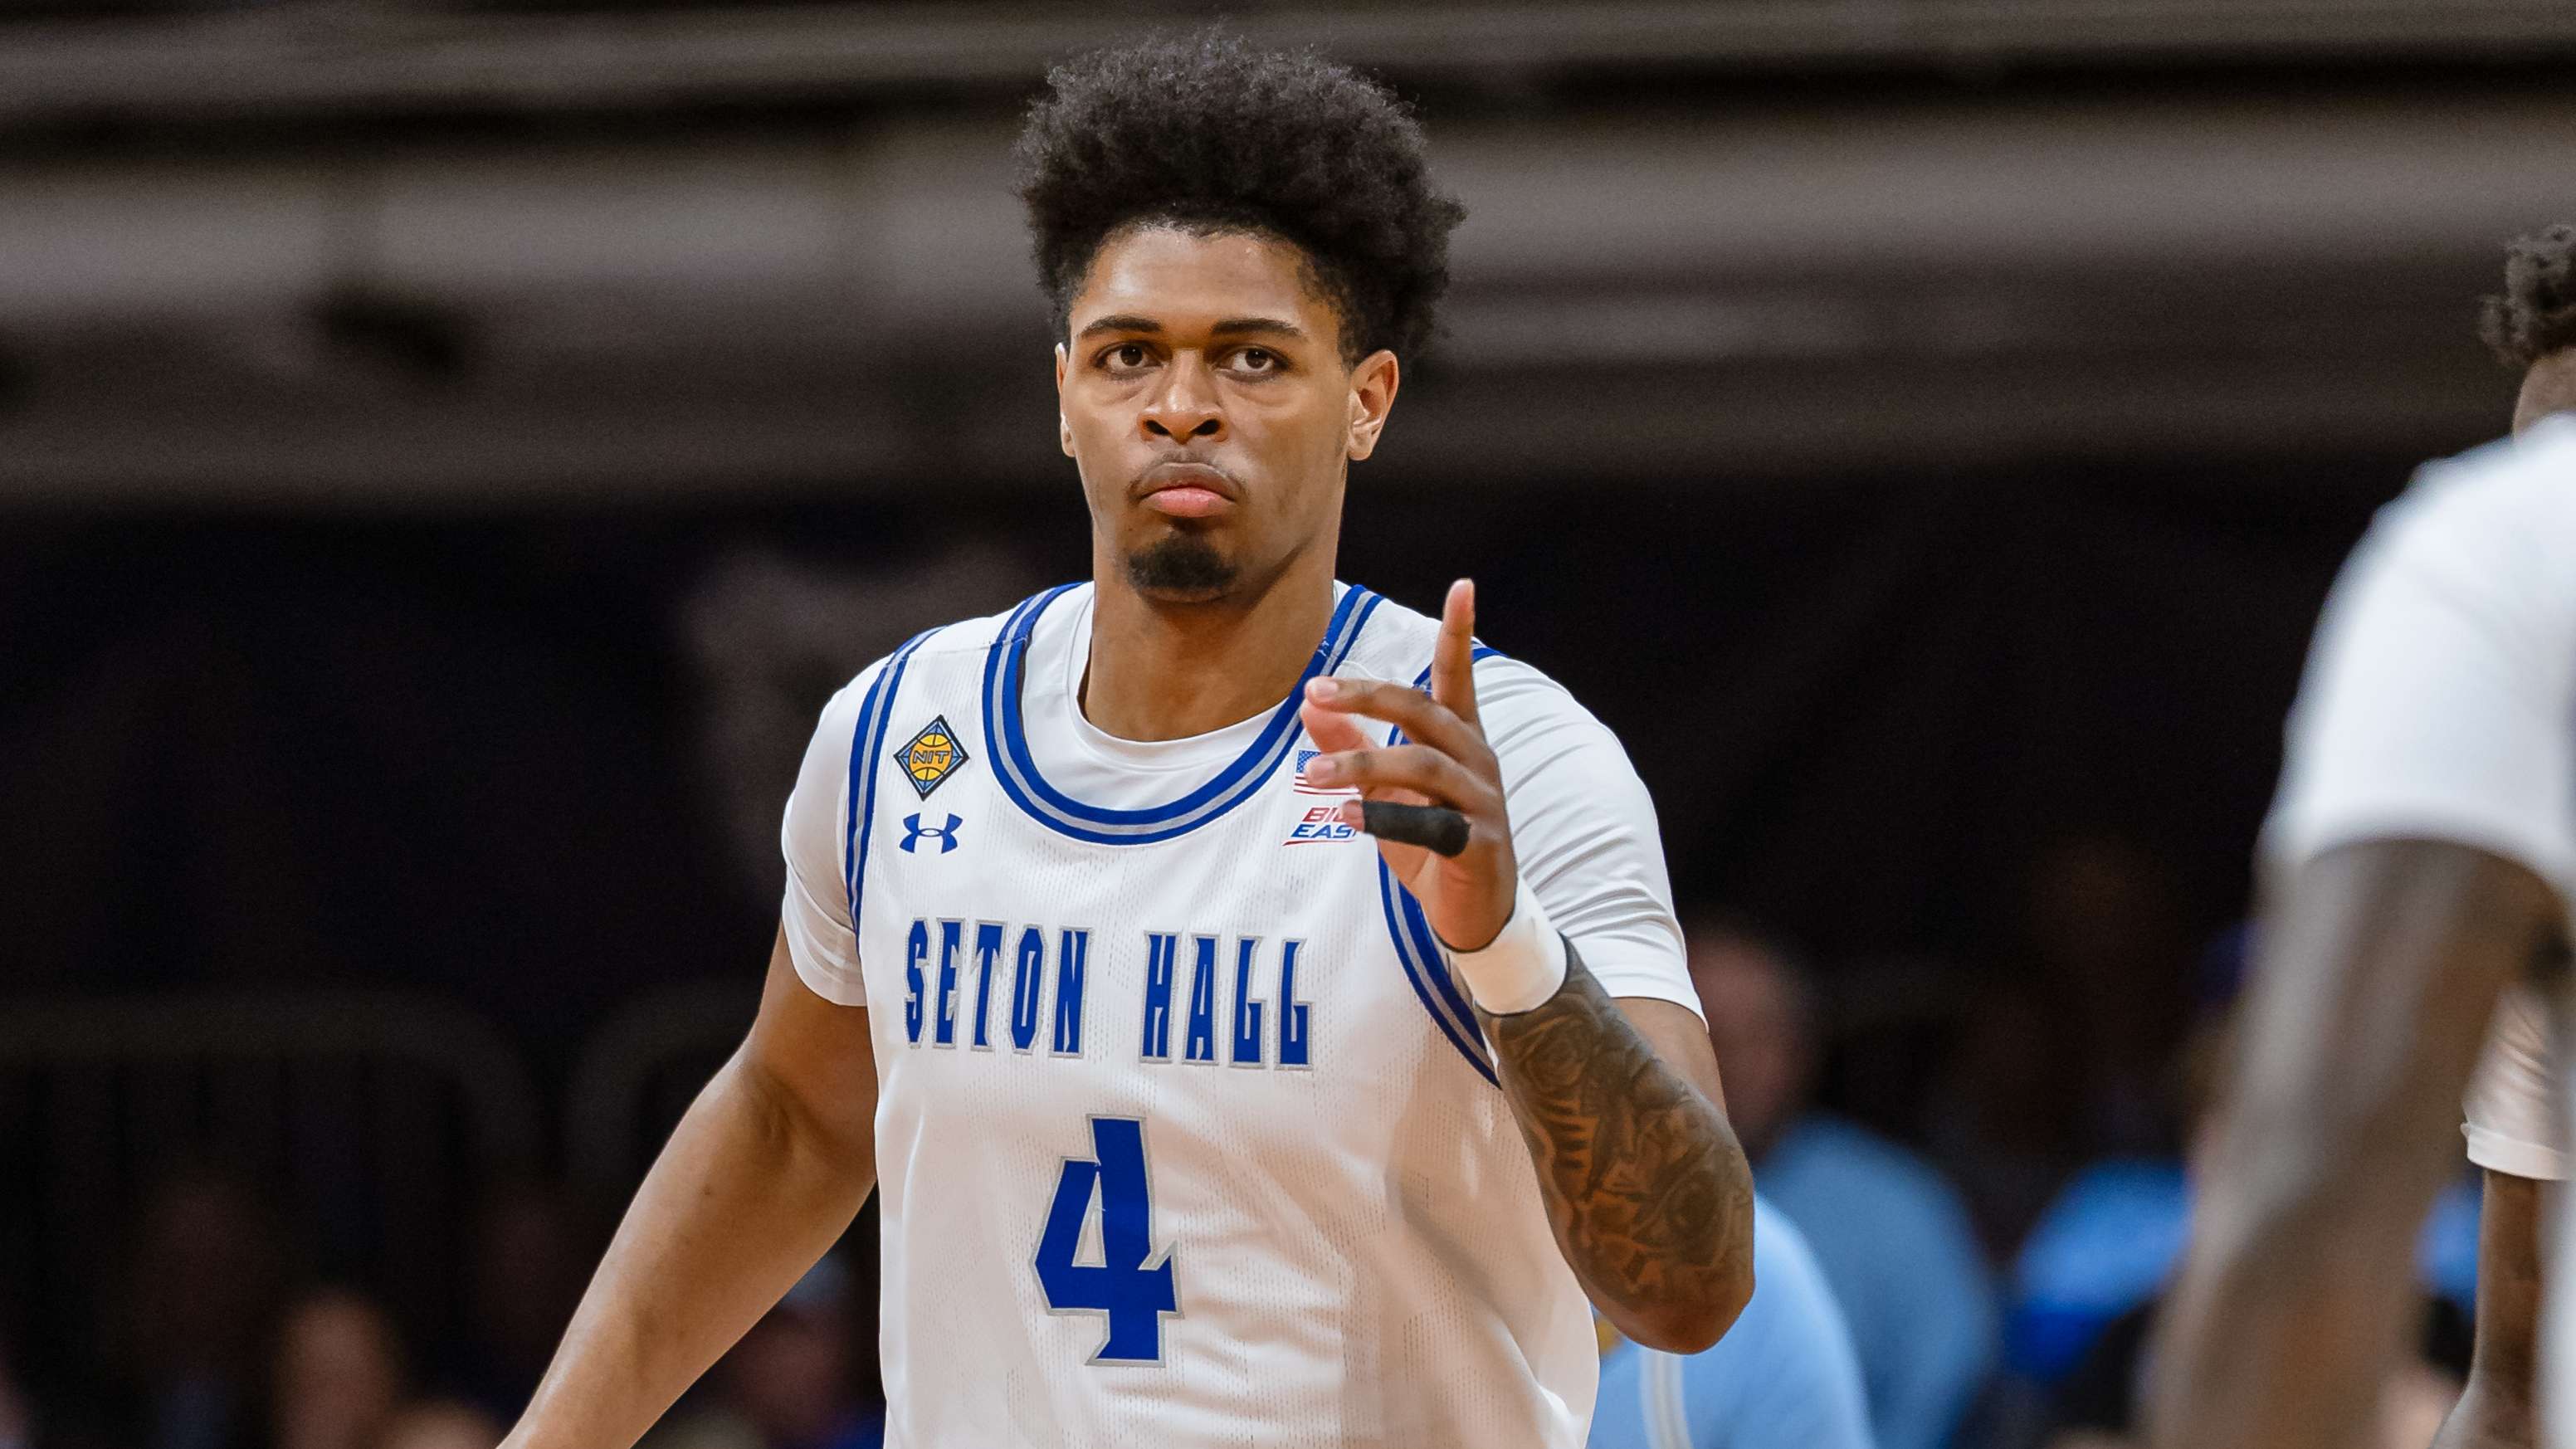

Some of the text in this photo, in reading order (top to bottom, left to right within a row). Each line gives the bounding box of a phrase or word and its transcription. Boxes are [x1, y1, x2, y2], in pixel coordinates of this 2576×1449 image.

[912, 749, 950, 764] NIT
[1301, 807, 1343, 822] BI
[904, 917, 1314, 1071] SETON HALL
[1027, 1113, 1185, 1368] 4
